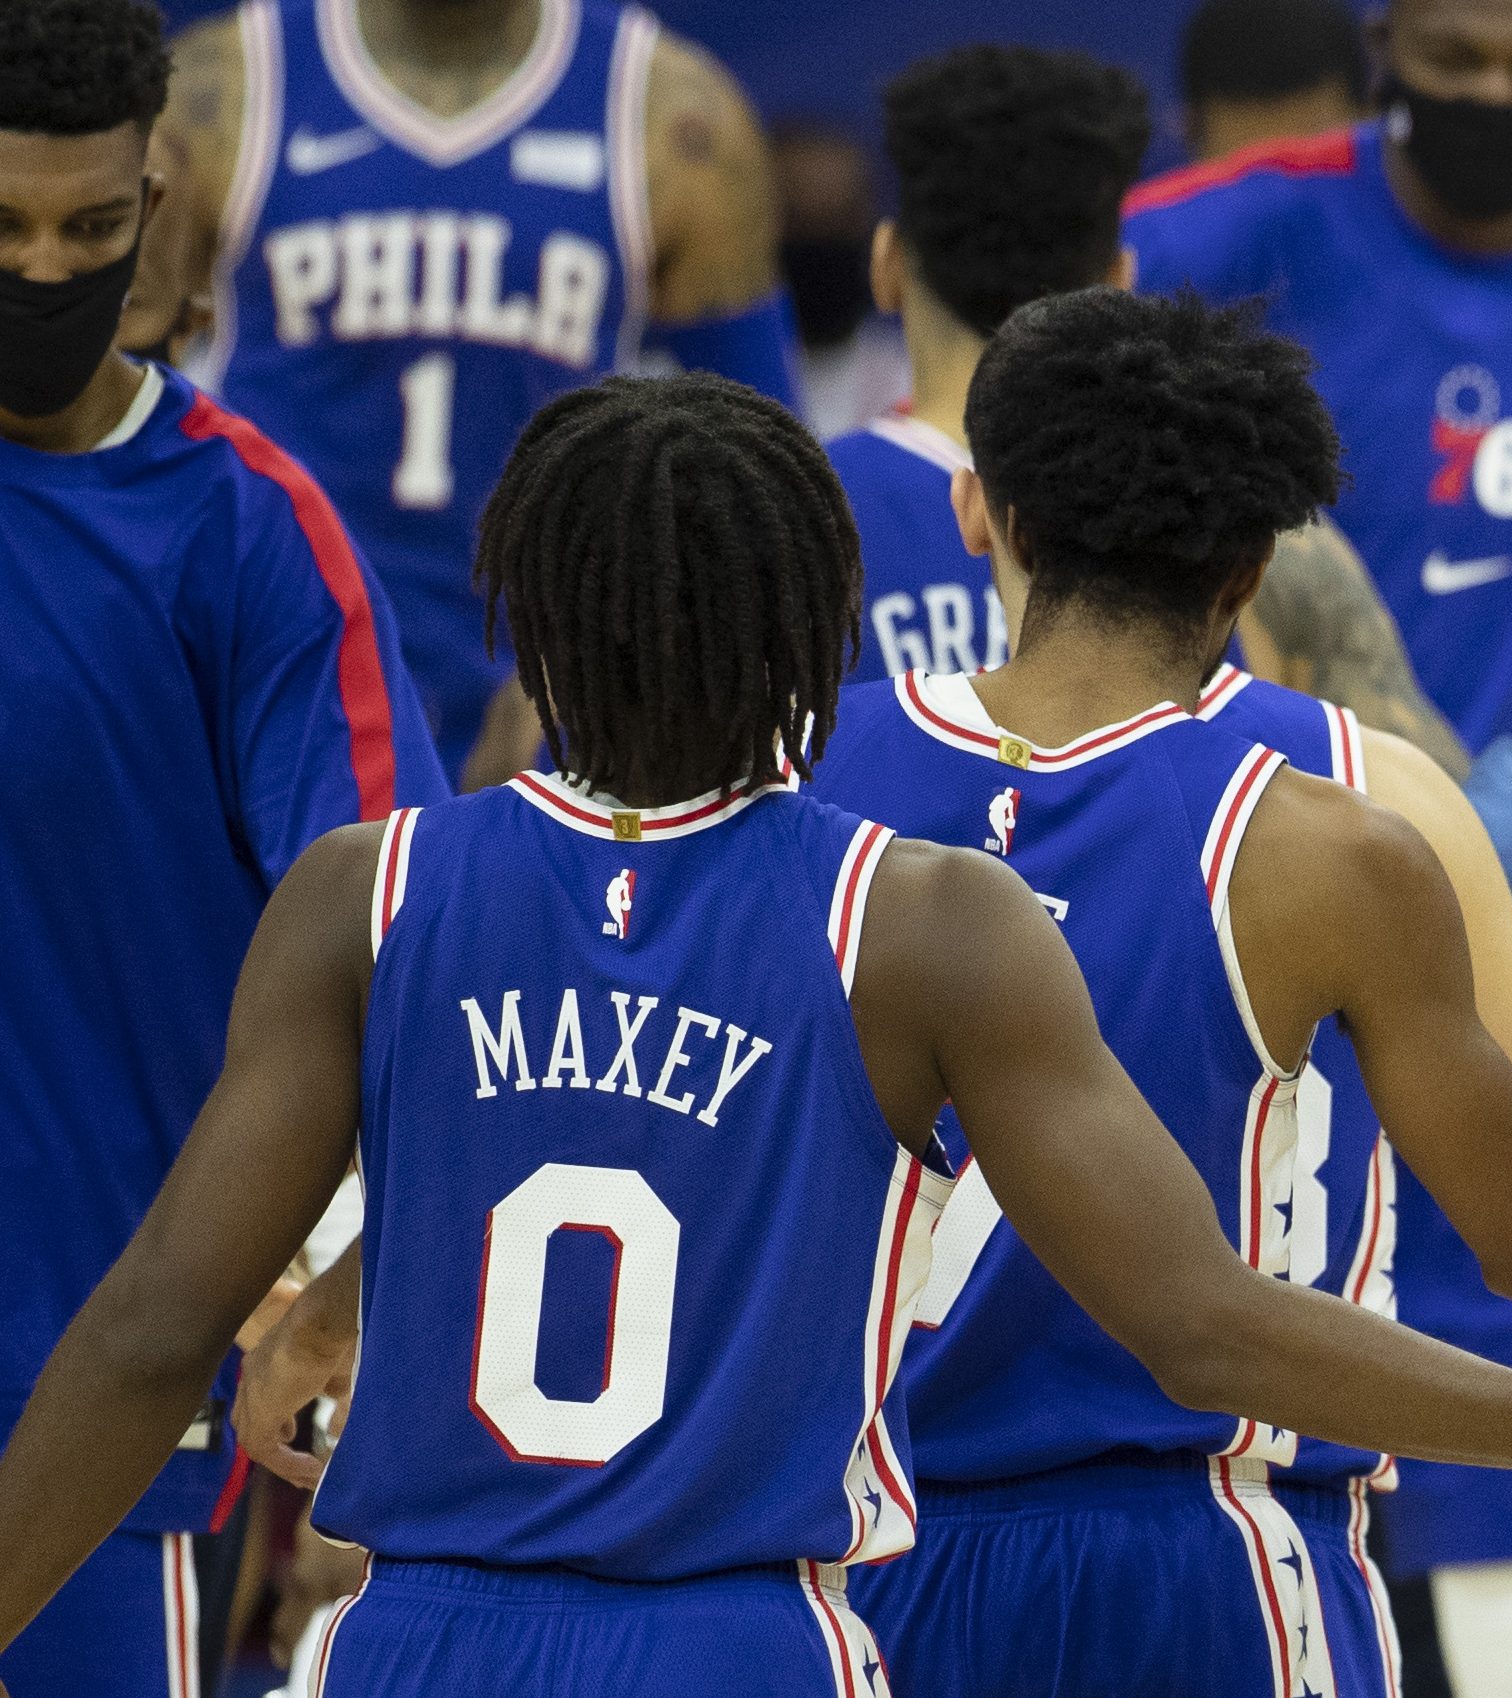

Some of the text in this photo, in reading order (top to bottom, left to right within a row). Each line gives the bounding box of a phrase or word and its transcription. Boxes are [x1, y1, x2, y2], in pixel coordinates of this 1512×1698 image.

[263, 210, 609, 370] PHILA
[392, 354, 455, 508] 1
[460, 988, 773, 1128] MAXEY
[468, 1162, 681, 1468] 0
